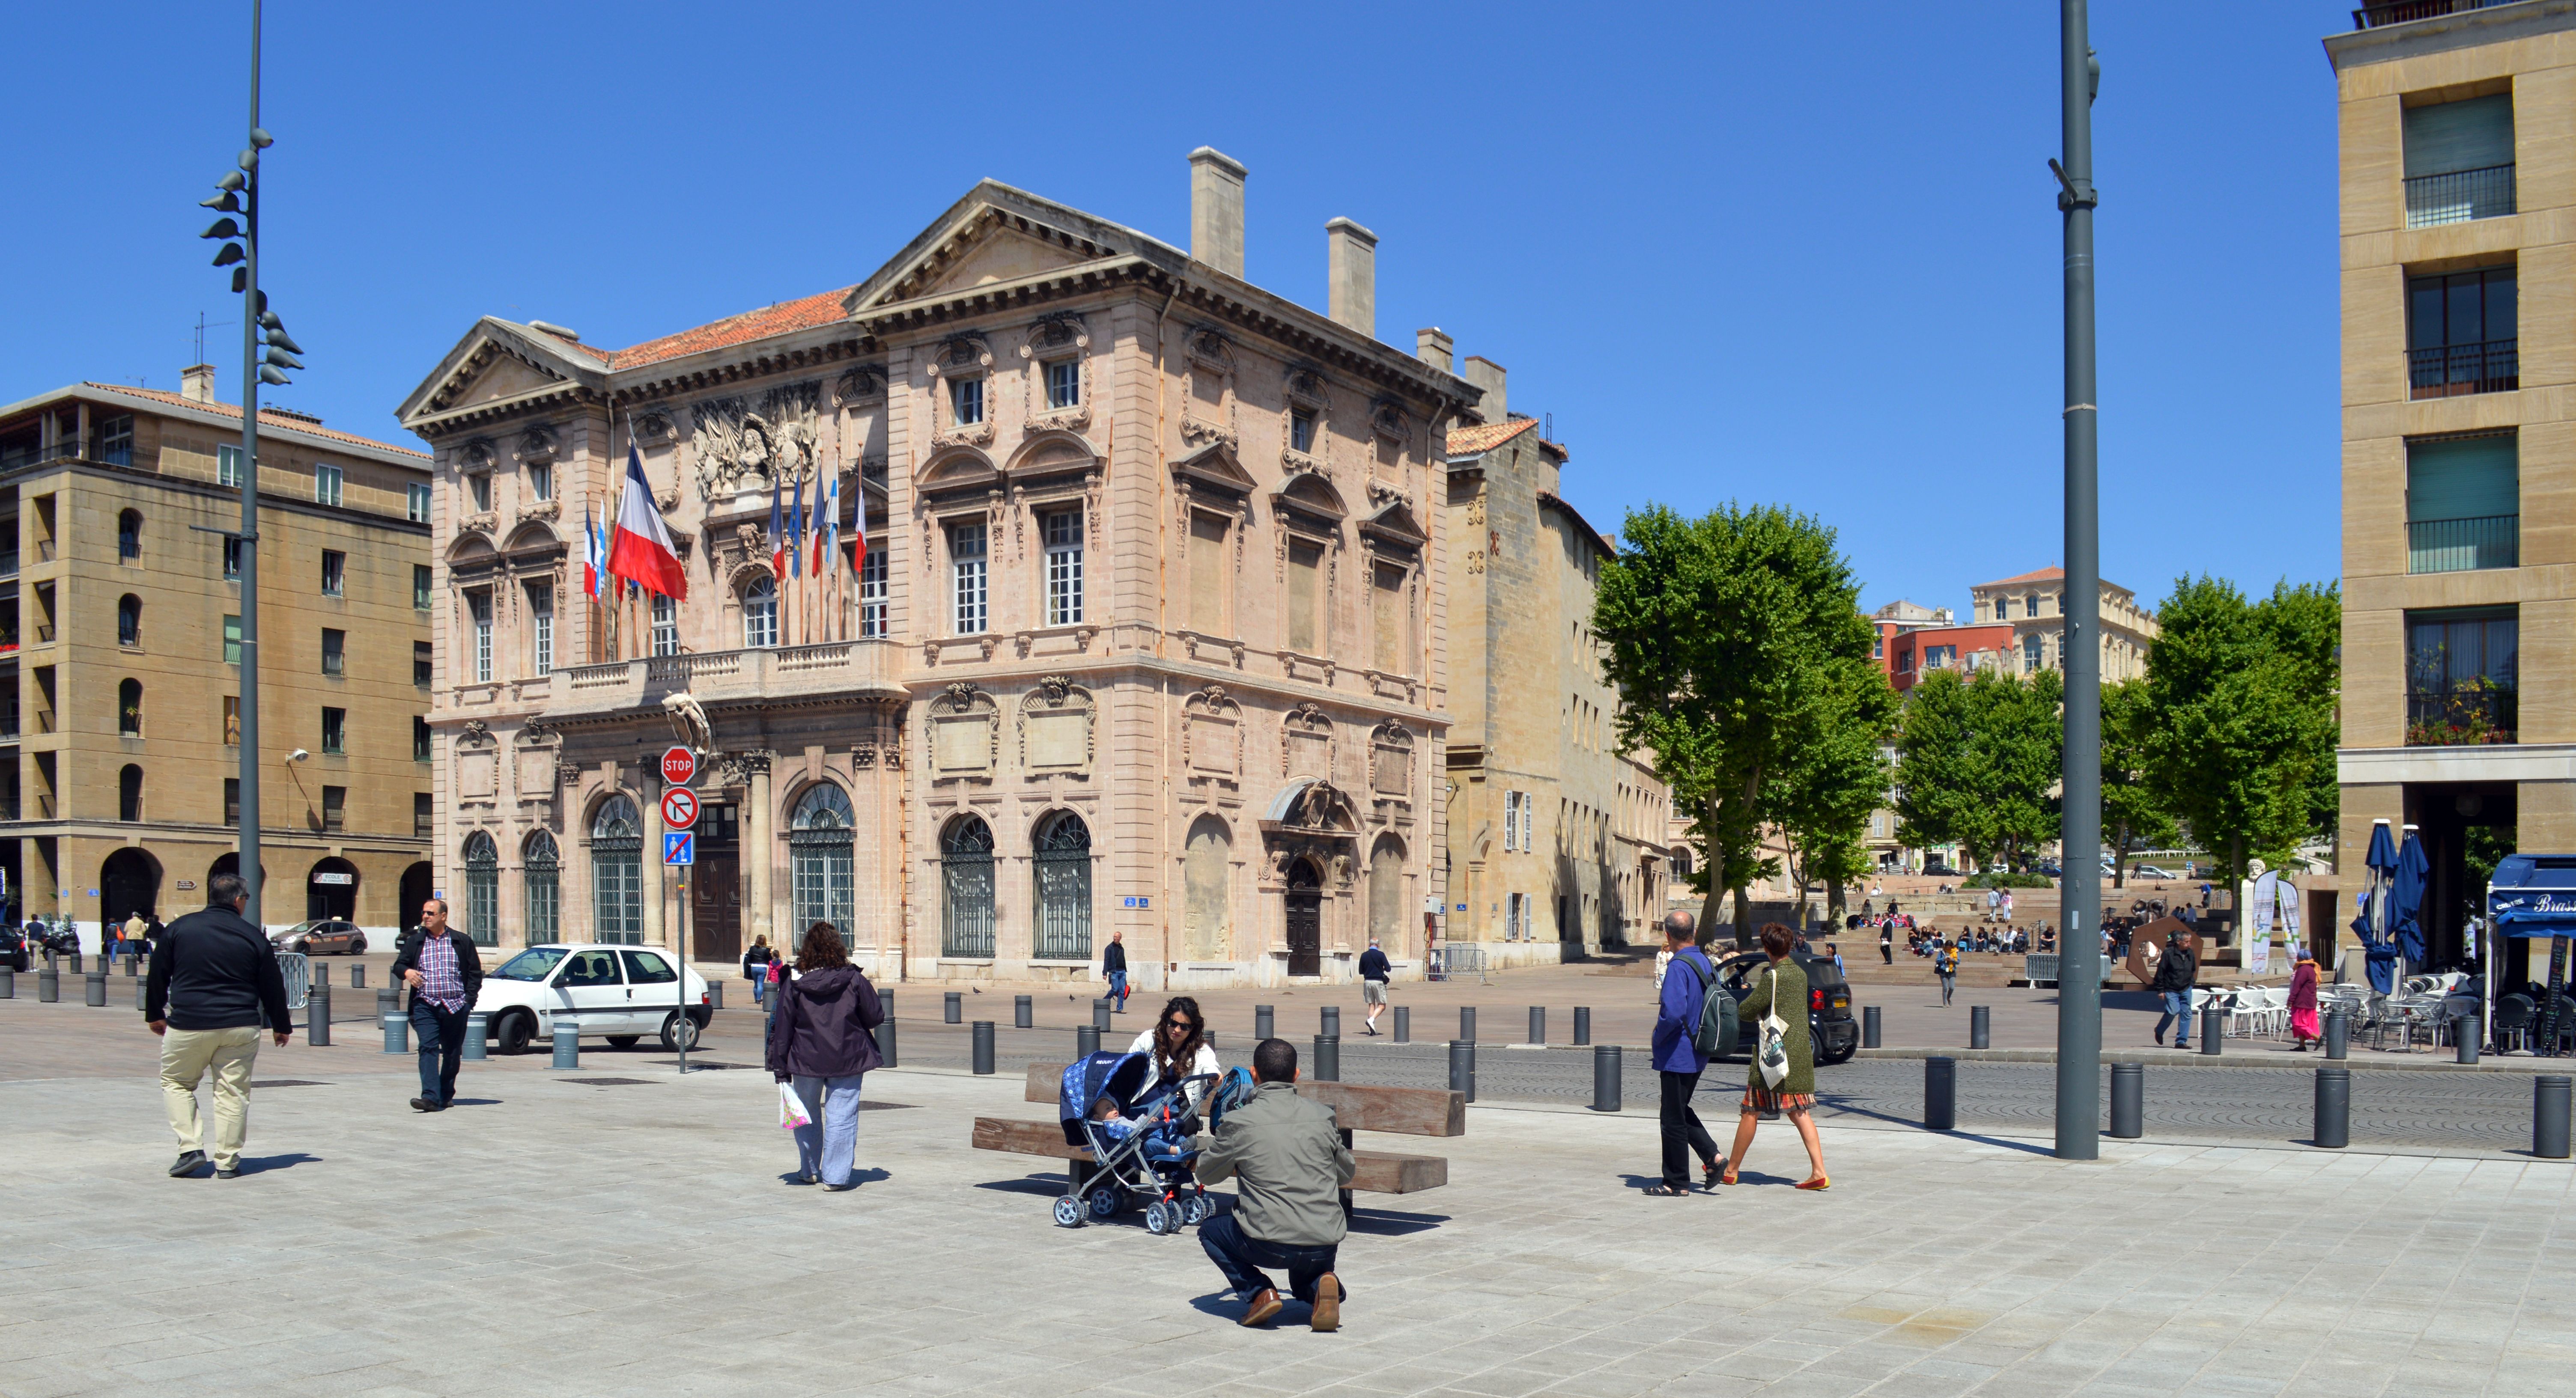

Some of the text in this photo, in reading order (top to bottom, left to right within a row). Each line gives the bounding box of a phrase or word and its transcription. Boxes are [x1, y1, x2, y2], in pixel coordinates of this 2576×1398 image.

[665, 760, 692, 771] STOP
[2534, 894, 2576, 912] Brass
[1762, 1033, 1782, 1059] nova
